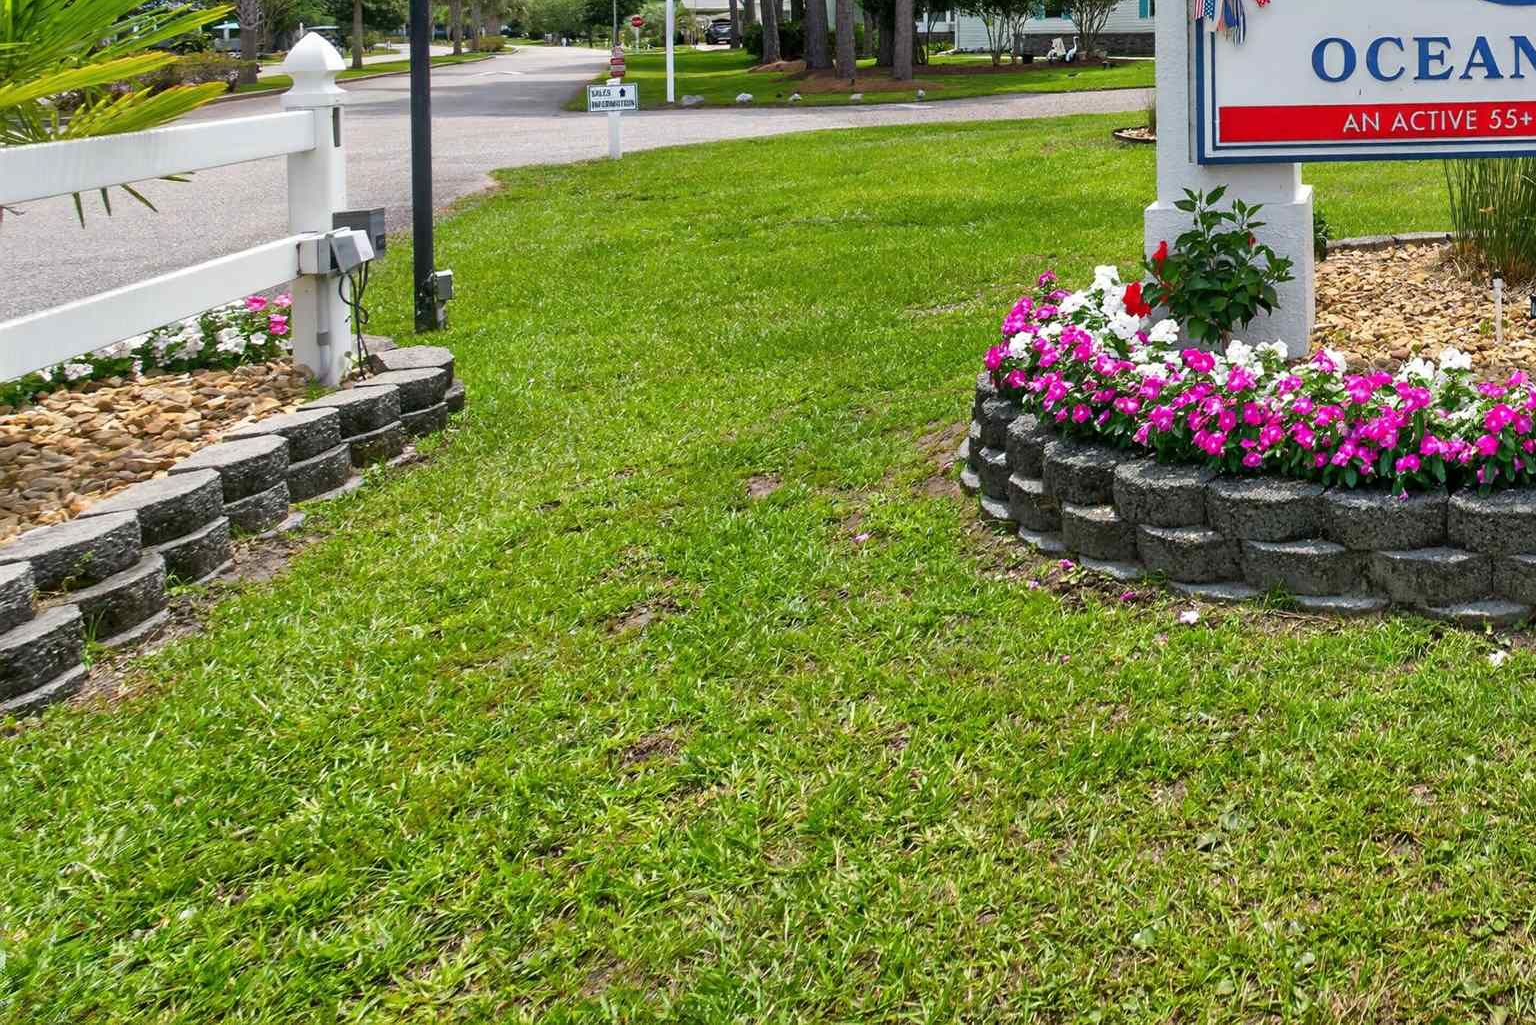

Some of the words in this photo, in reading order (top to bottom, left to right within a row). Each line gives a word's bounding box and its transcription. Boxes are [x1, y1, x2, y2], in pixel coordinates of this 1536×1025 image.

[1343, 111, 1380, 133] AN
[1391, 109, 1477, 132] ACTIVE
[1488, 108, 1533, 130] 55+
